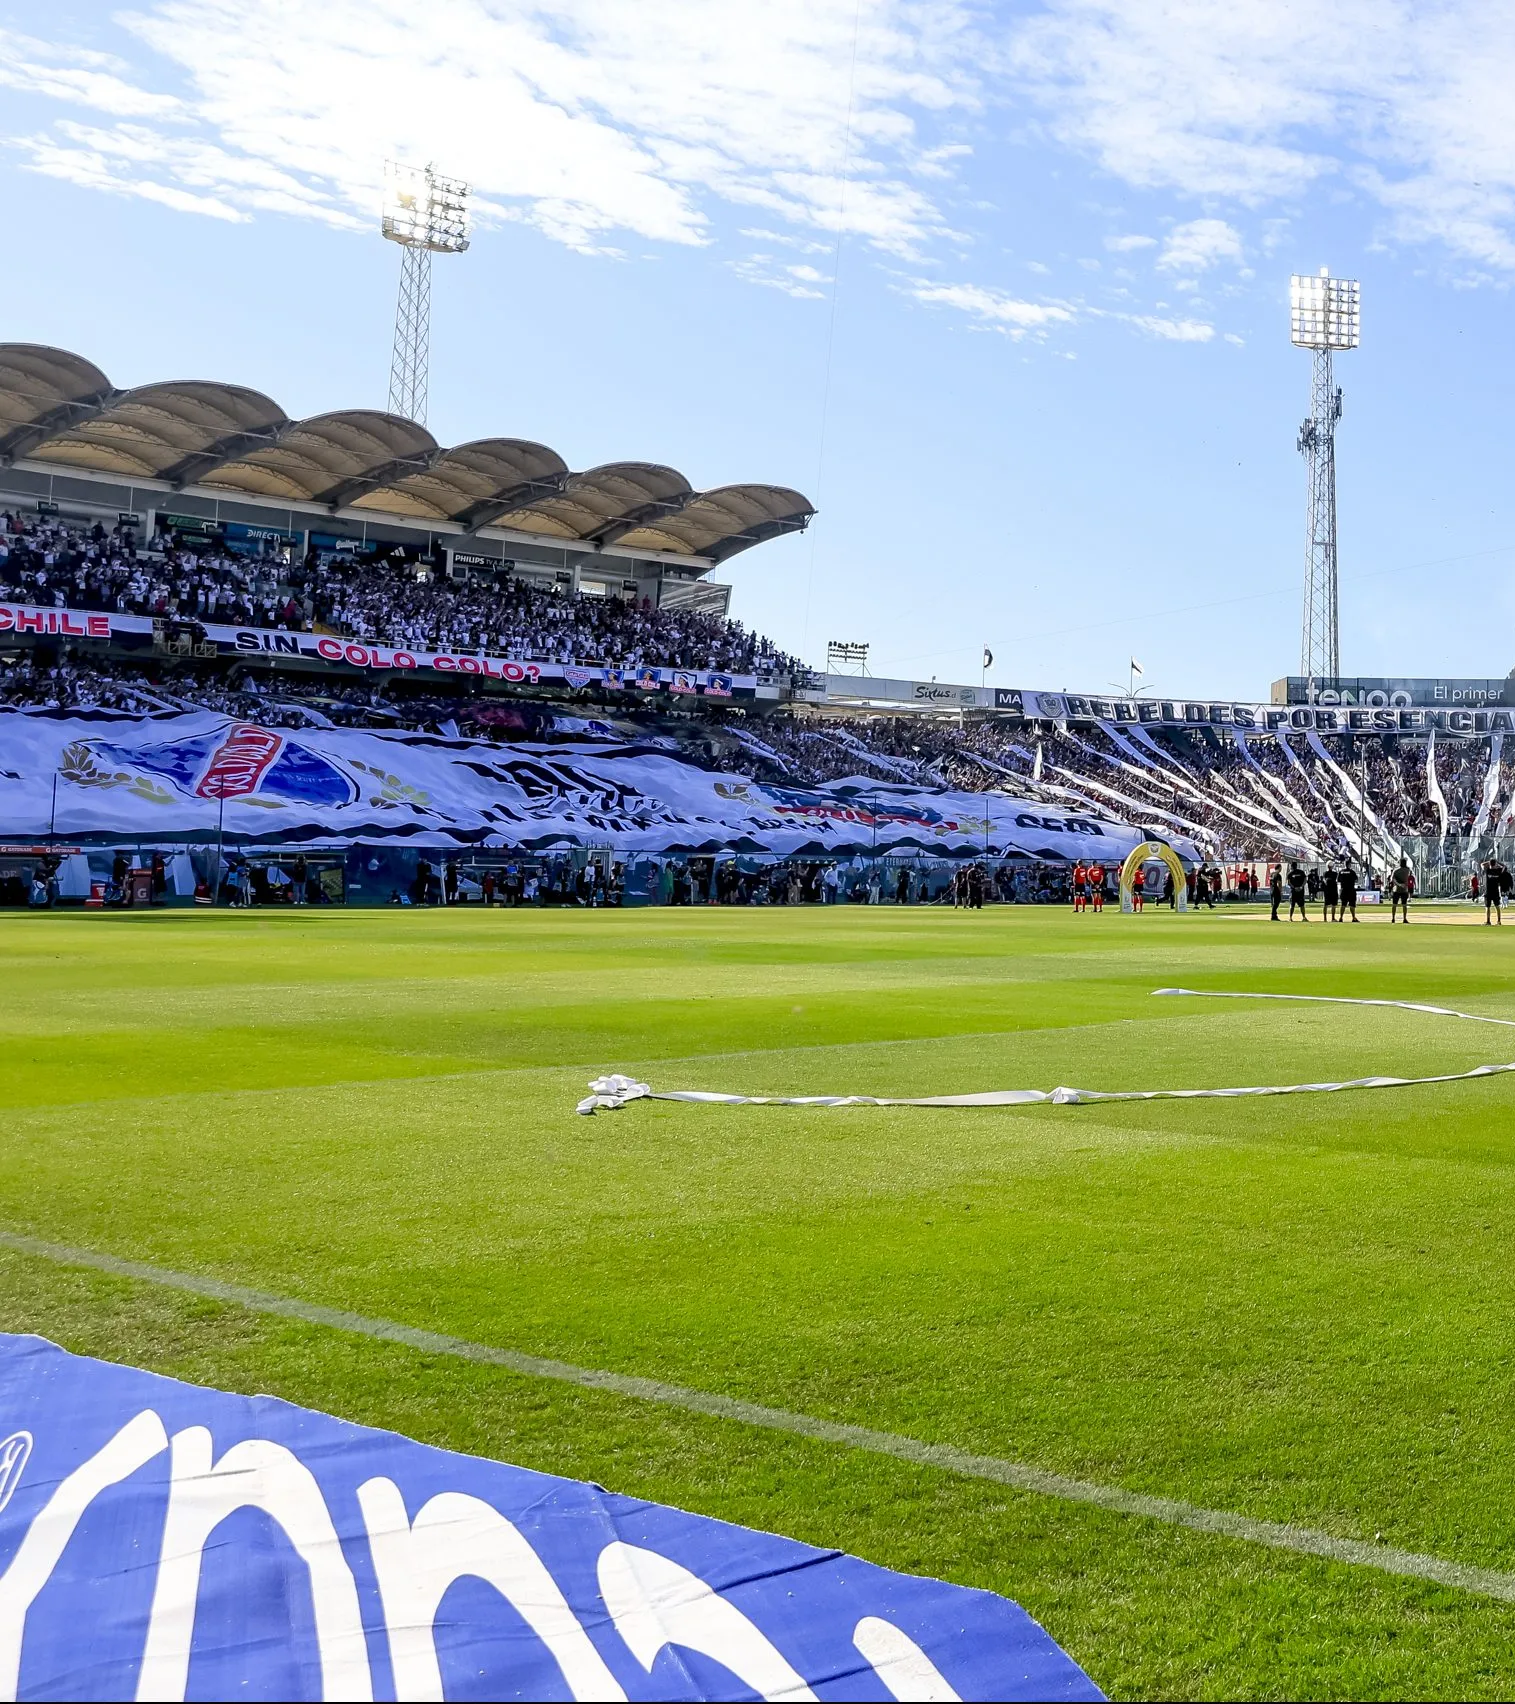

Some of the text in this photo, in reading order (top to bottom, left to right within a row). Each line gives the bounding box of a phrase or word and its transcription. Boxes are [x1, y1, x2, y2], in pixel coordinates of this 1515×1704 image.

[455, 554, 485, 565] PHILIPS
[235, 631, 302, 655] SIN
[317, 638, 418, 669] COLO
[1434, 686, 1503, 702] El primer
[1266, 709, 1338, 731] POR
[1350, 710, 1515, 732] ESENCIA
